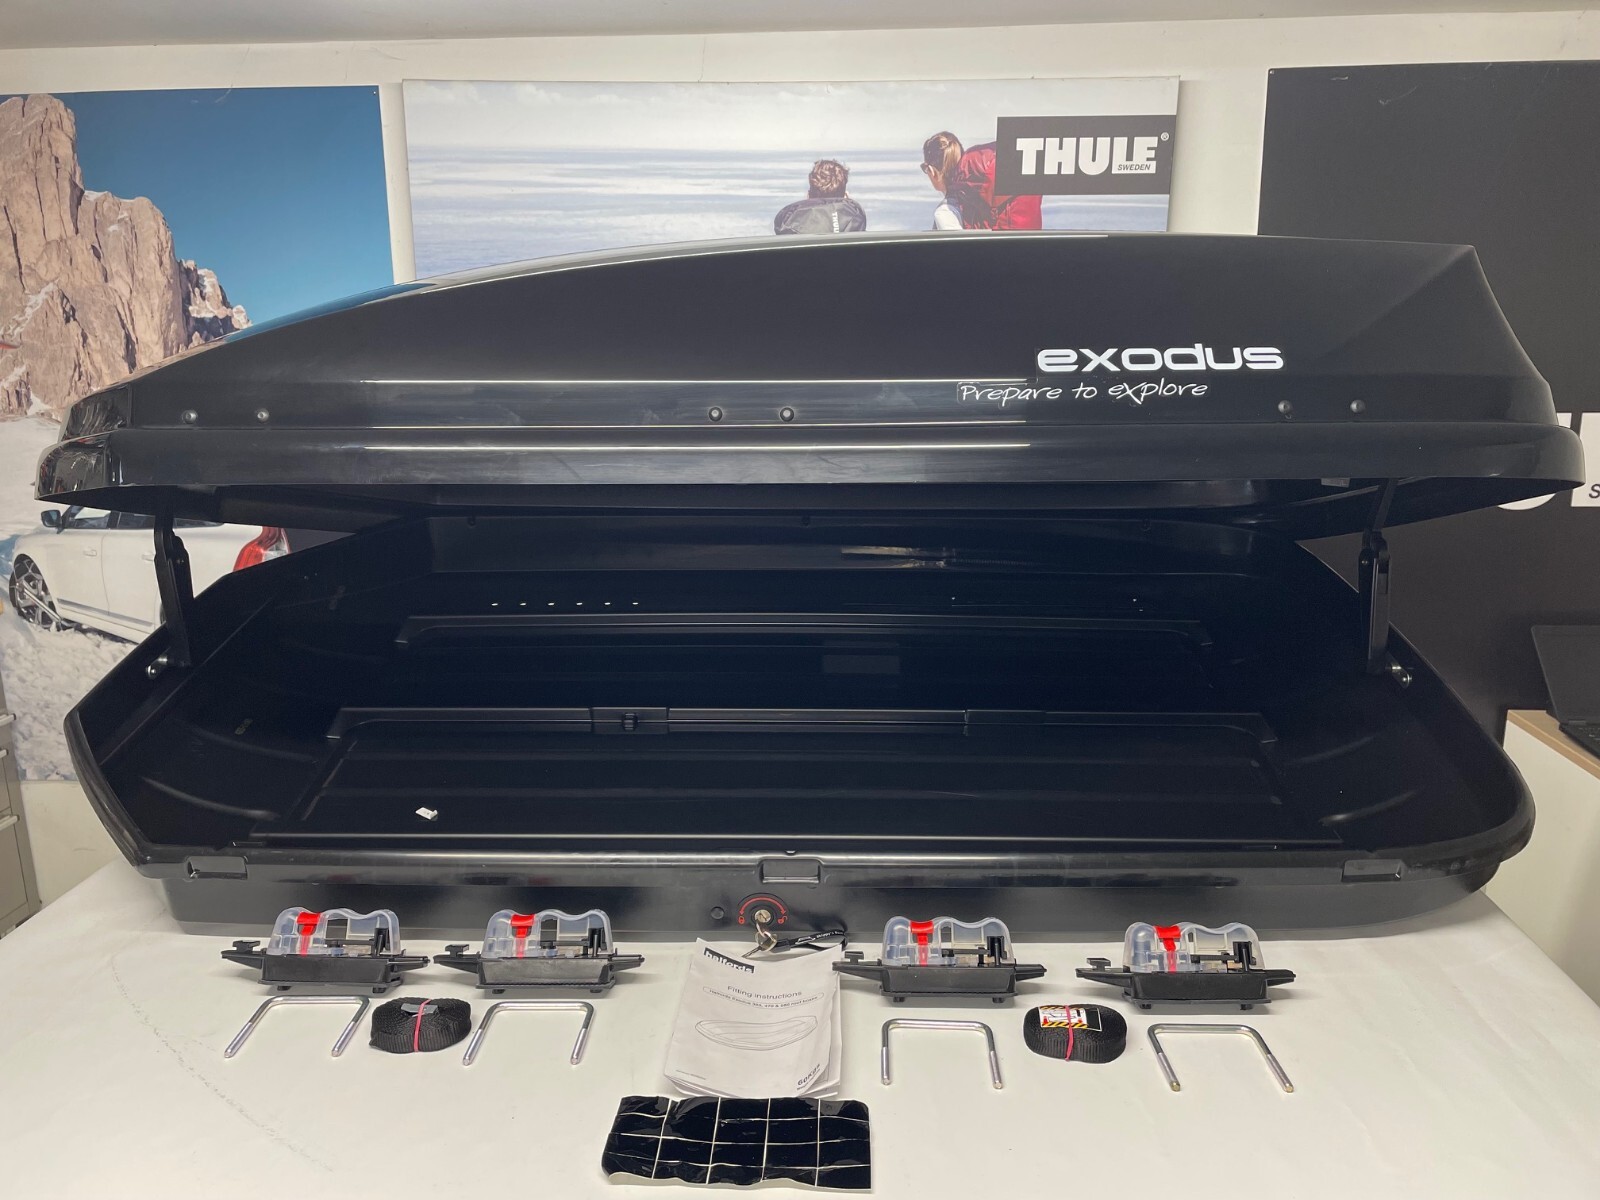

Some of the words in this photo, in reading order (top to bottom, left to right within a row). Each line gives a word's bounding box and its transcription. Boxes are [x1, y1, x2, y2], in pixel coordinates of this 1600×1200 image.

[1016, 136, 1159, 176] THULE
[1117, 163, 1151, 171] SWEDEN
[1037, 343, 1284, 372] exodus
[960, 384, 1063, 407] Prepare
[1072, 382, 1097, 399] to
[1108, 378, 1208, 405] explore
[727, 985, 753, 998] Fitting
[754, 991, 802, 1000] instructions
